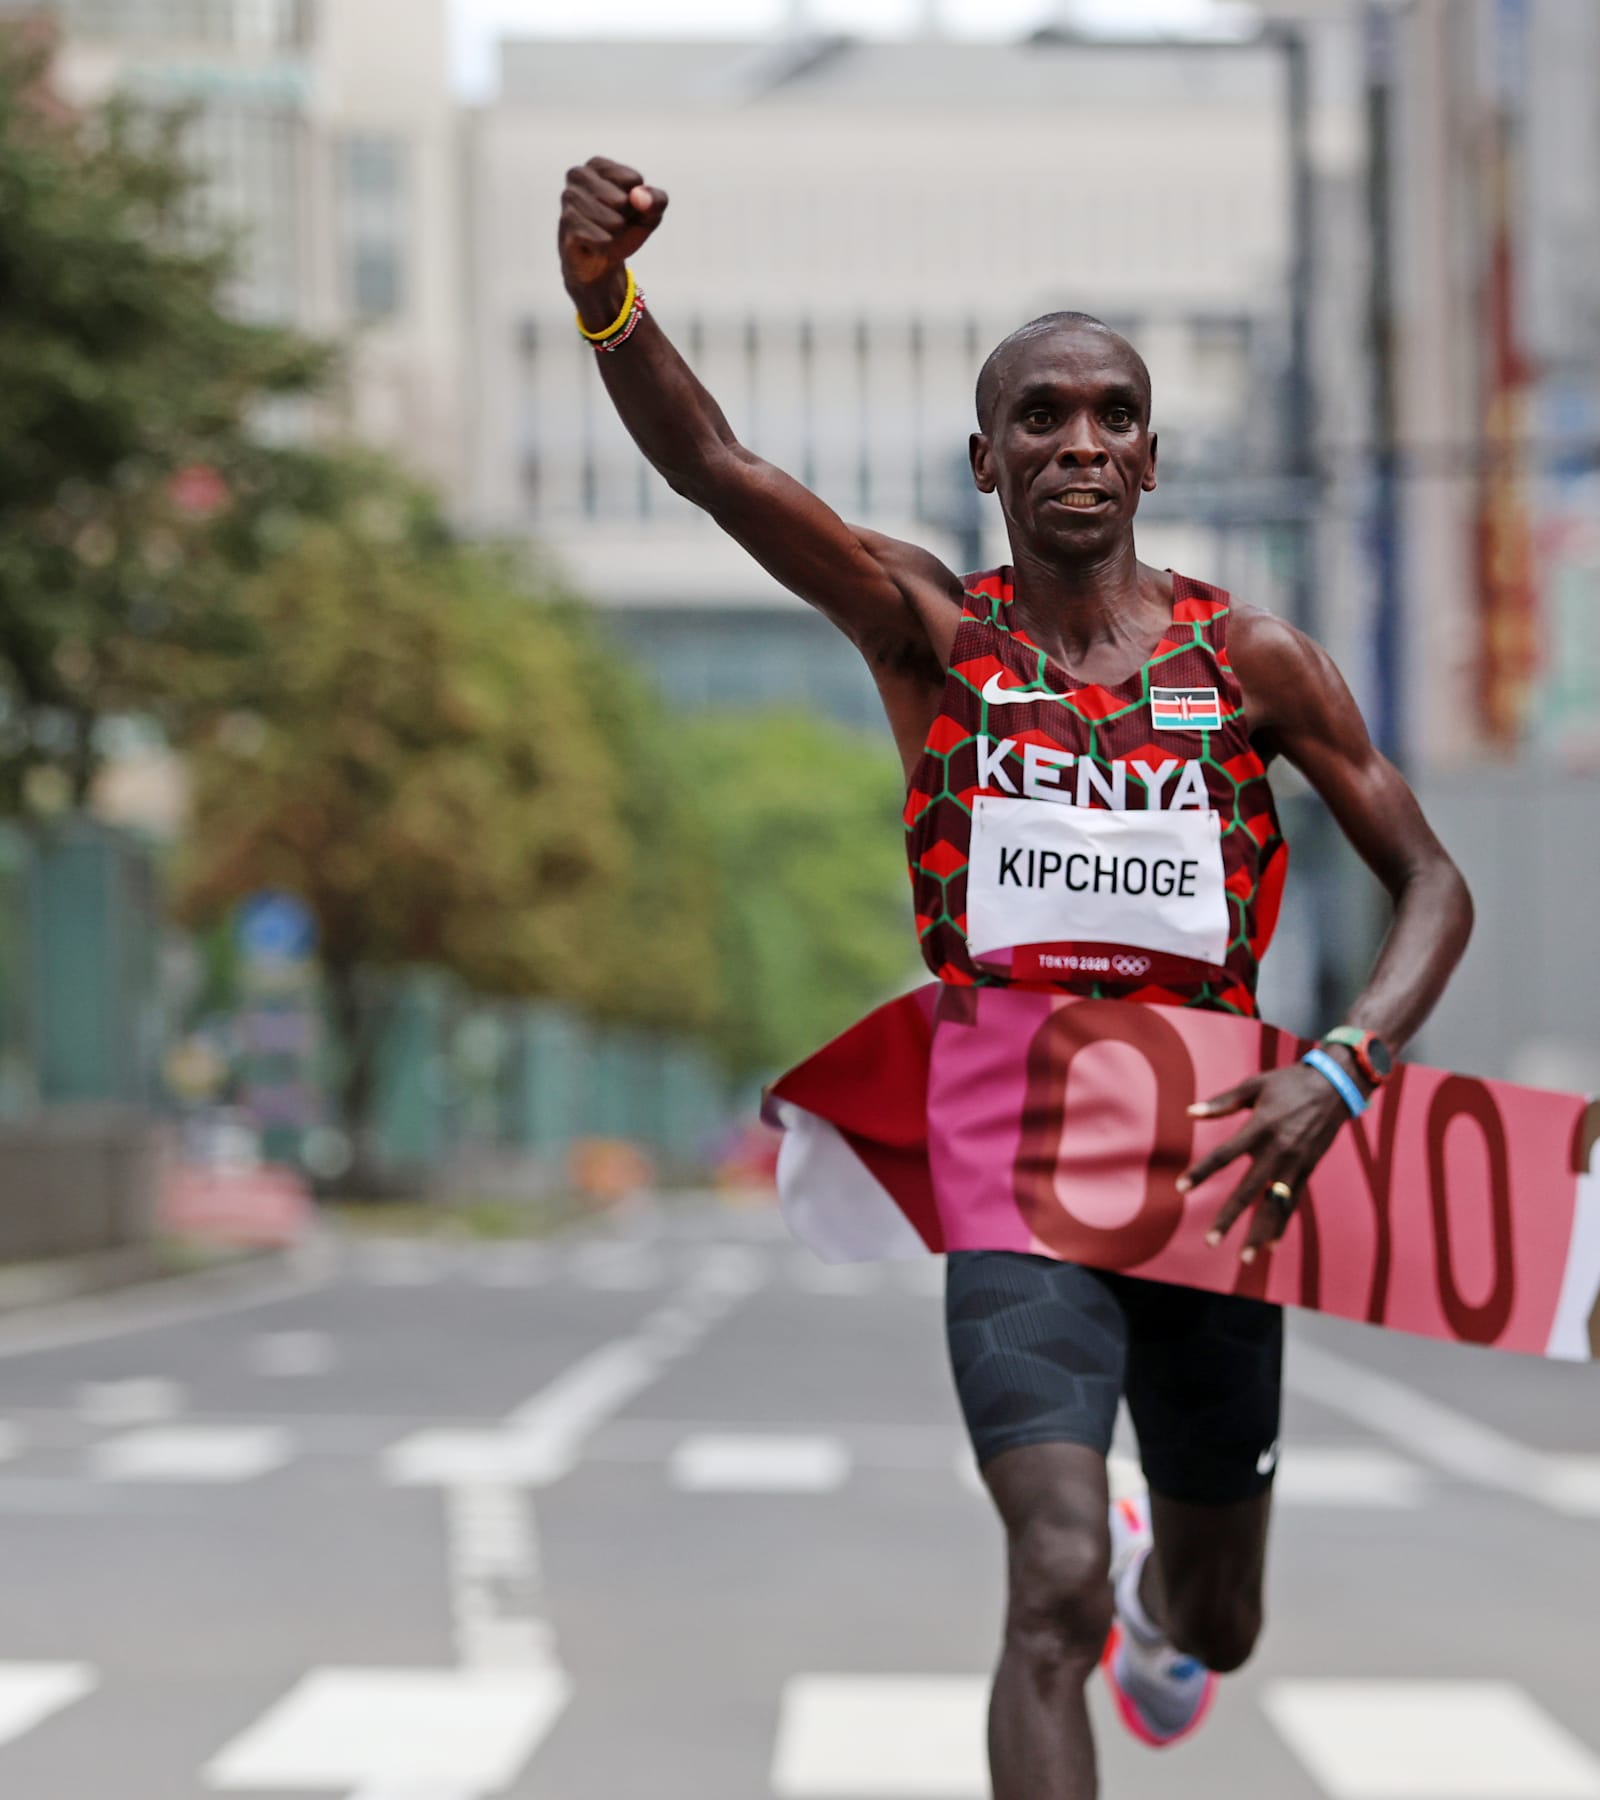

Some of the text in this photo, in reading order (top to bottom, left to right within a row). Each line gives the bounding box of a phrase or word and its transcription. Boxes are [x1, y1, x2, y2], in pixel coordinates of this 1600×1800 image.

[976, 735, 1210, 811] KENYA
[999, 847, 1199, 897] KIPCHOGE
[1038, 954, 1110, 971] TOKYO 2020
[934, 985, 1516, 1346] OYO
